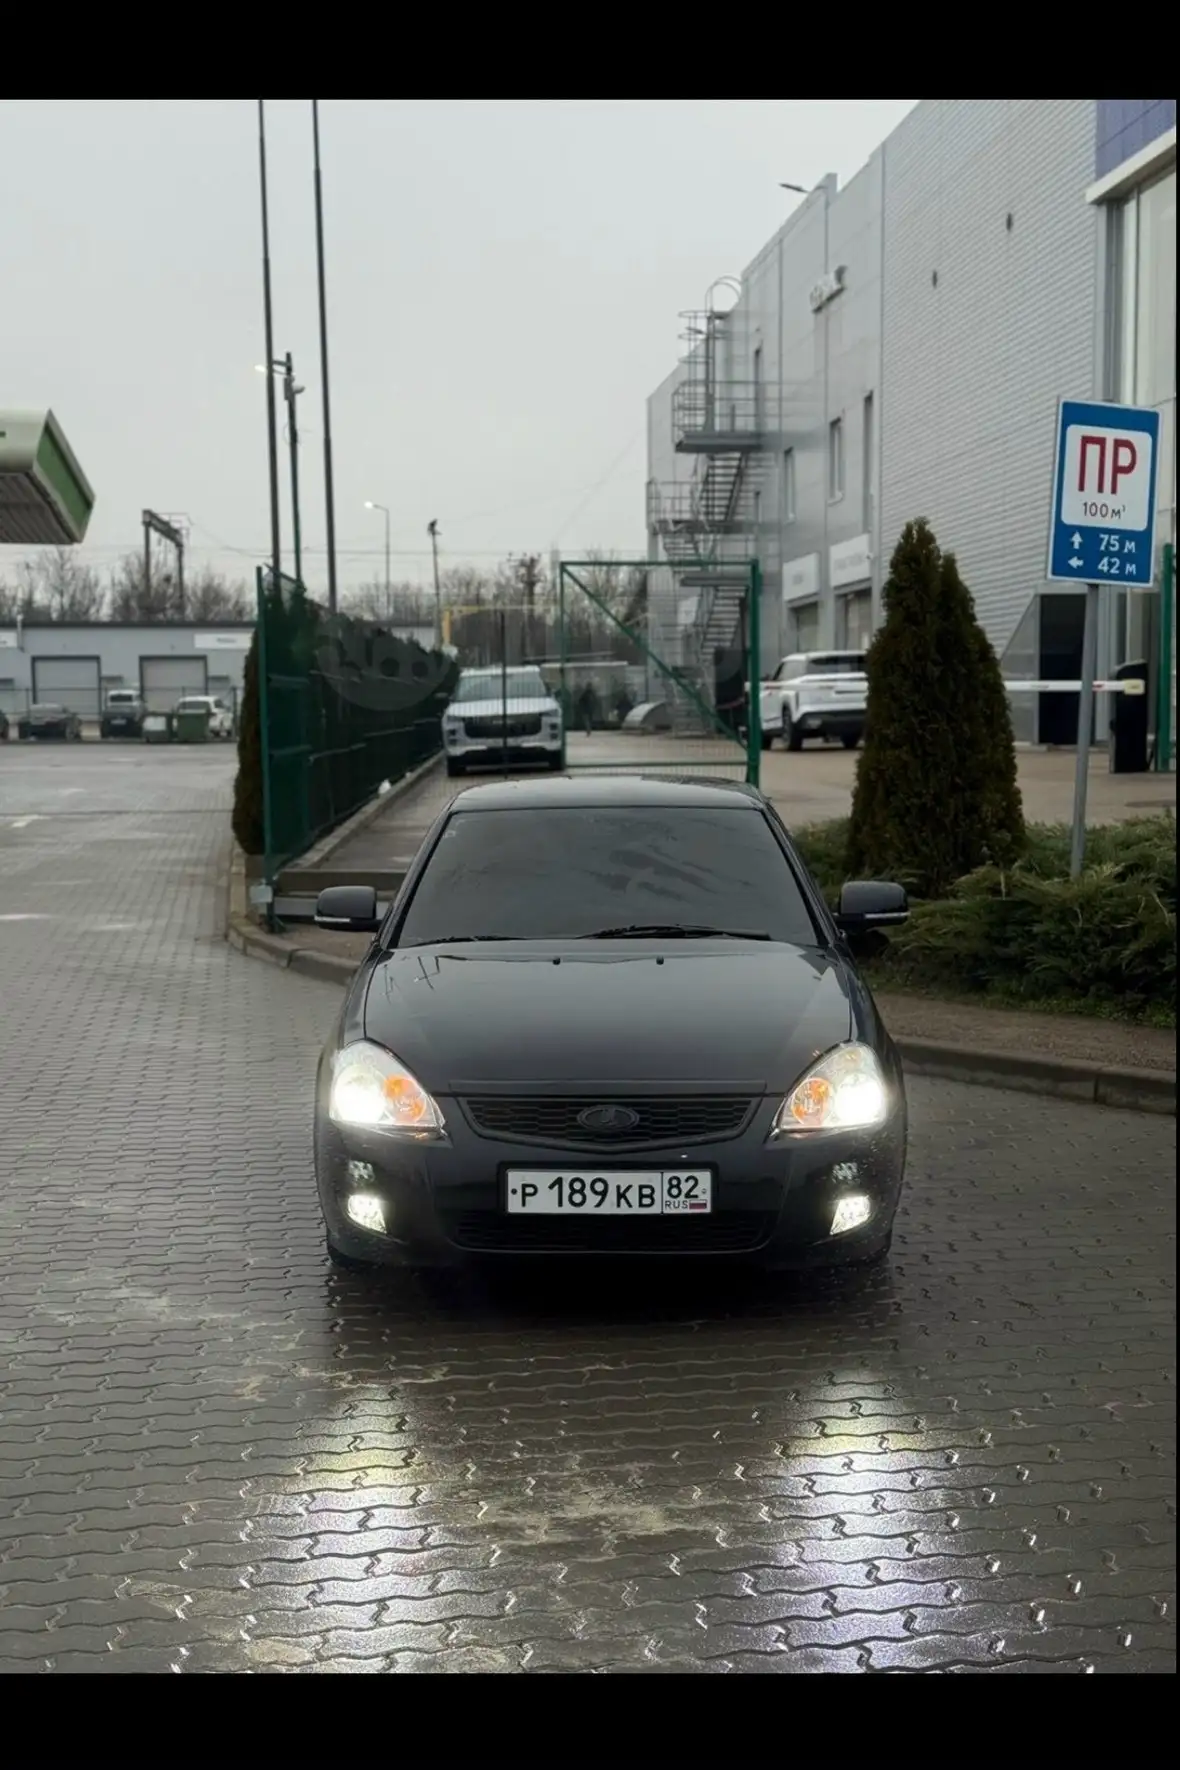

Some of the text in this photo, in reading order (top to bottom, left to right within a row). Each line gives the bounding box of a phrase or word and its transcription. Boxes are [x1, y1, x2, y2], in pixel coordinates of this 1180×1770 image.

[1078, 434, 1138, 495] ПР
[1099, 534, 1120, 552] 75
[1098, 556, 1120, 575] 42
[666, 1175, 699, 1200] 82
[664, 1200, 689, 1210] RUS
